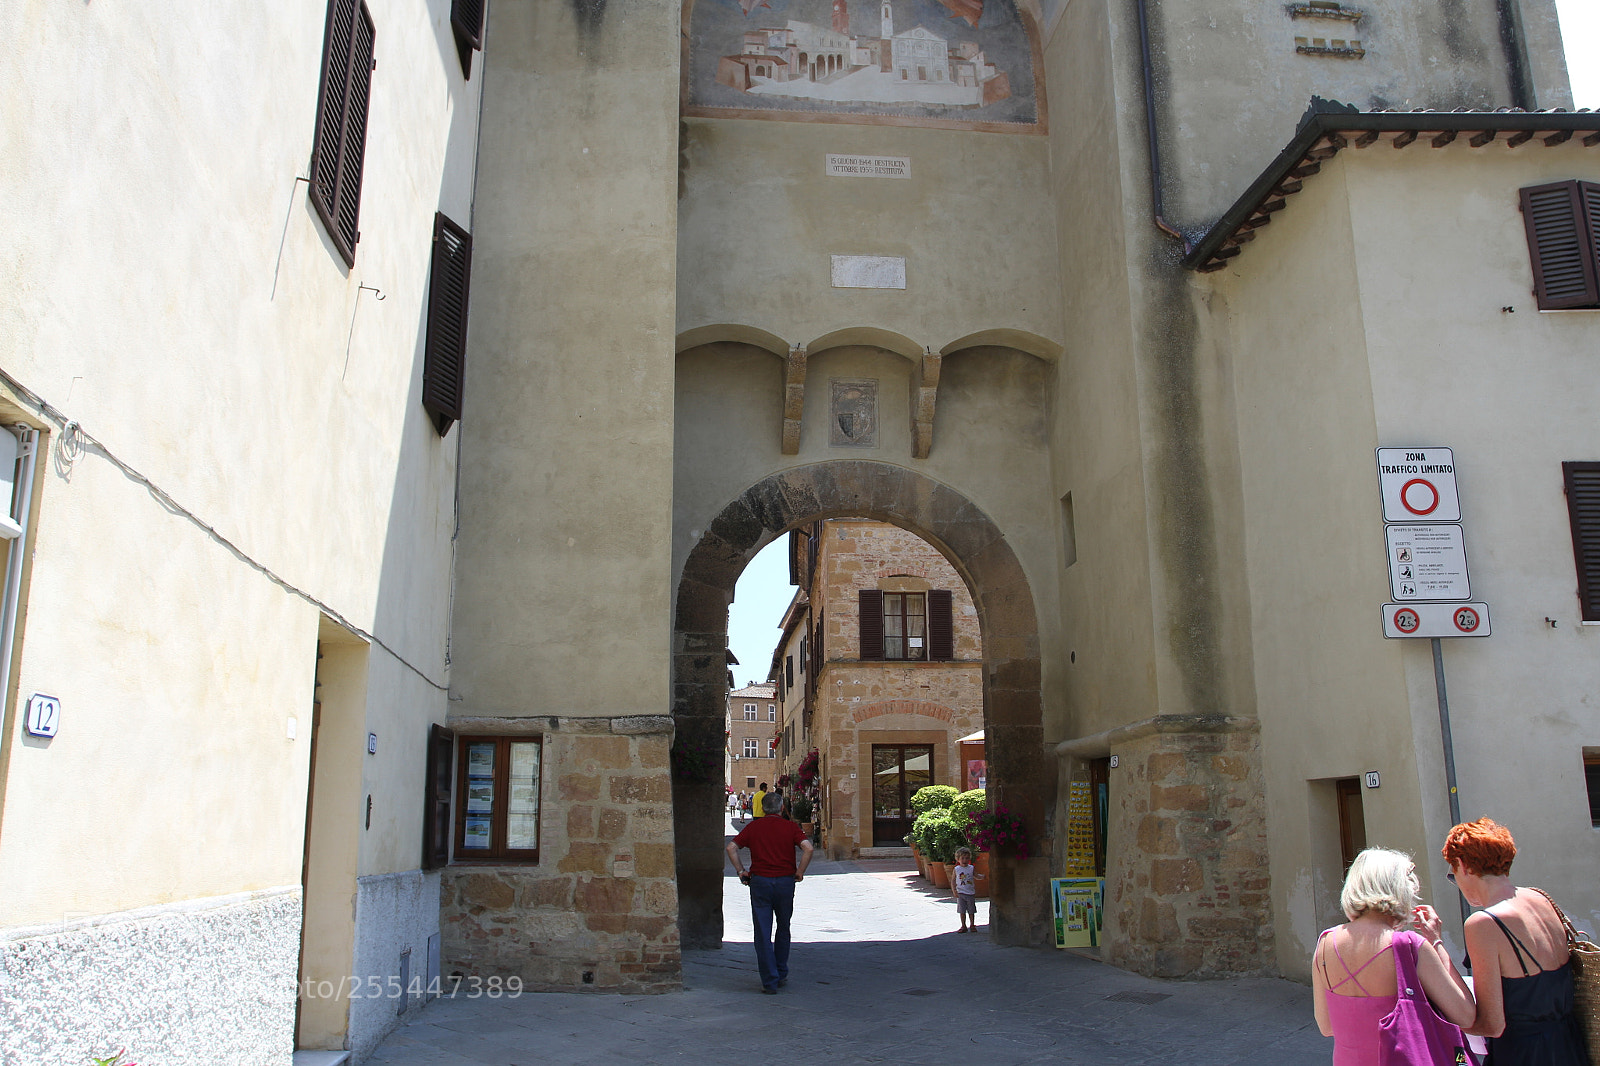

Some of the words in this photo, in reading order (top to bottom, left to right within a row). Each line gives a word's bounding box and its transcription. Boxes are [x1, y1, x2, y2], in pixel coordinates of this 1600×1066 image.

[833, 165, 859, 173] OTTOBRE
[1405, 453, 1426, 461] ZONA
[1381, 465, 1418, 474] TRAFFICO
[1420, 465, 1453, 474] LIMITATO
[35, 701, 53, 731] 12
[1368, 774, 1377, 786] 16
